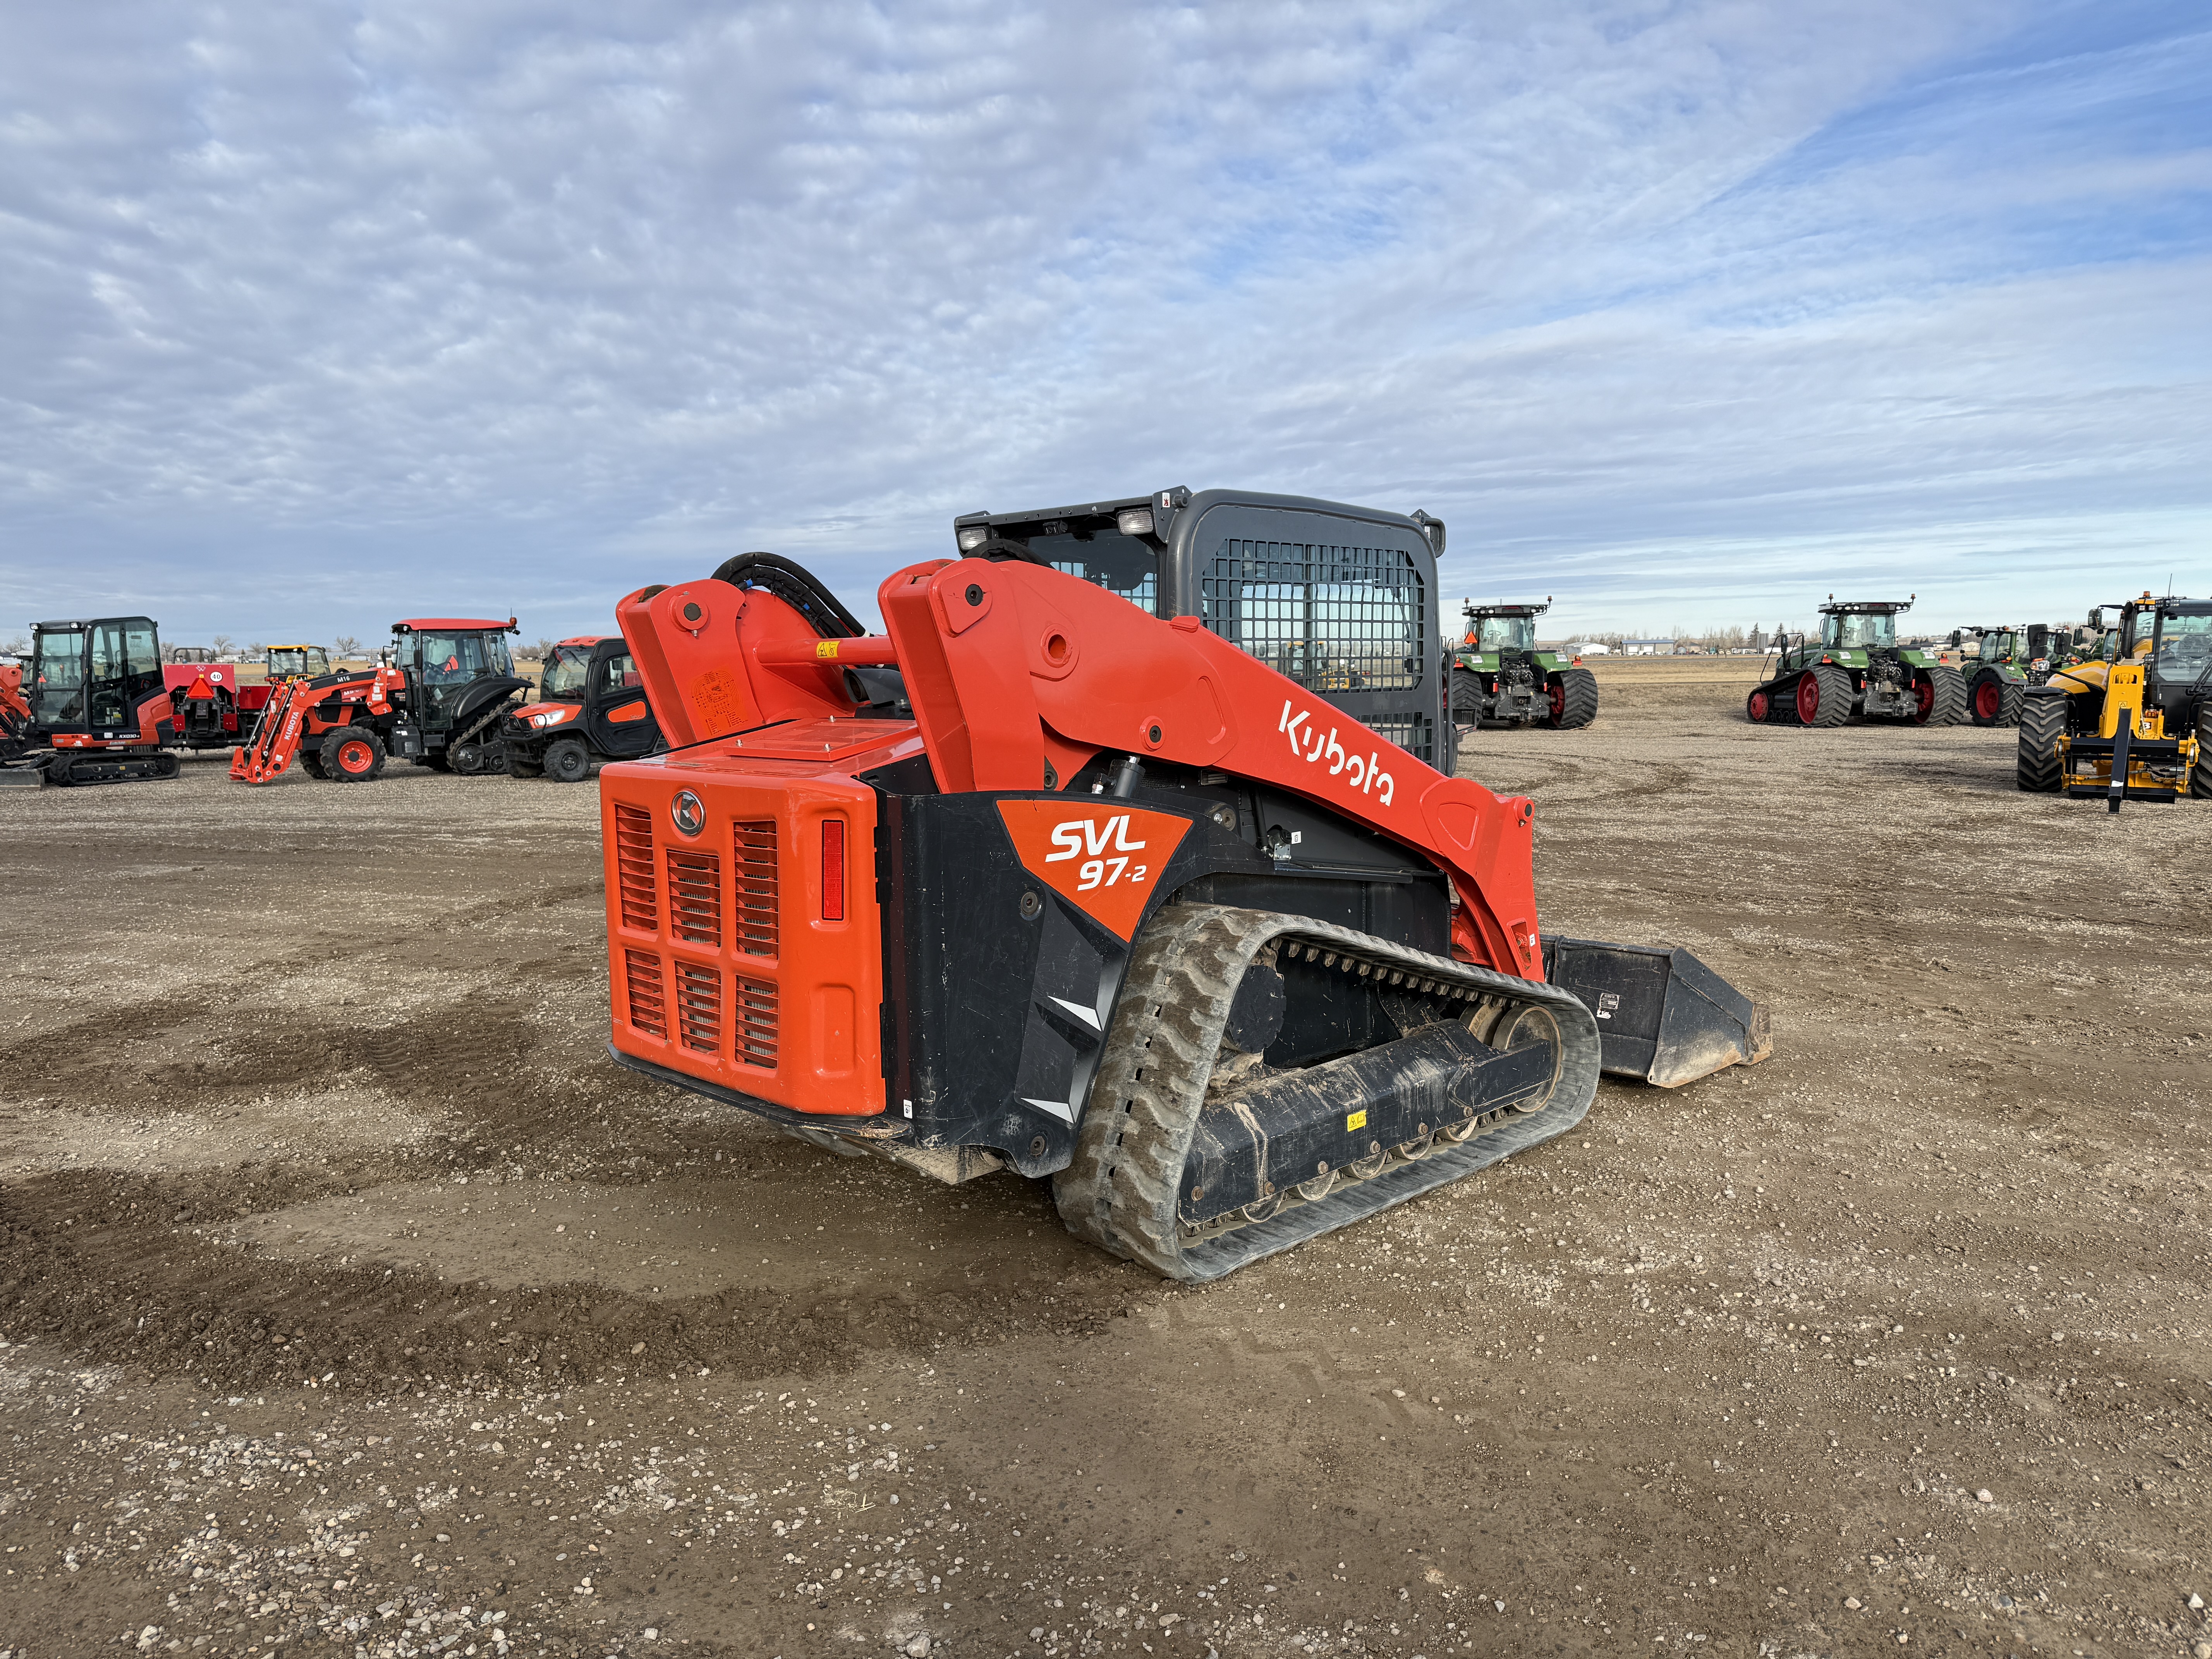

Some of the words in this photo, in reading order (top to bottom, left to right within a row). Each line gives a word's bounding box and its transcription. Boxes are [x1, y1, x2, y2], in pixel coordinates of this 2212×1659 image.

[284, 712, 299, 740] KUBOTA
[1278, 699, 1394, 807] Kubota
[1045, 815, 1146, 863] SVL
[1077, 856, 1147, 891] 97-2
